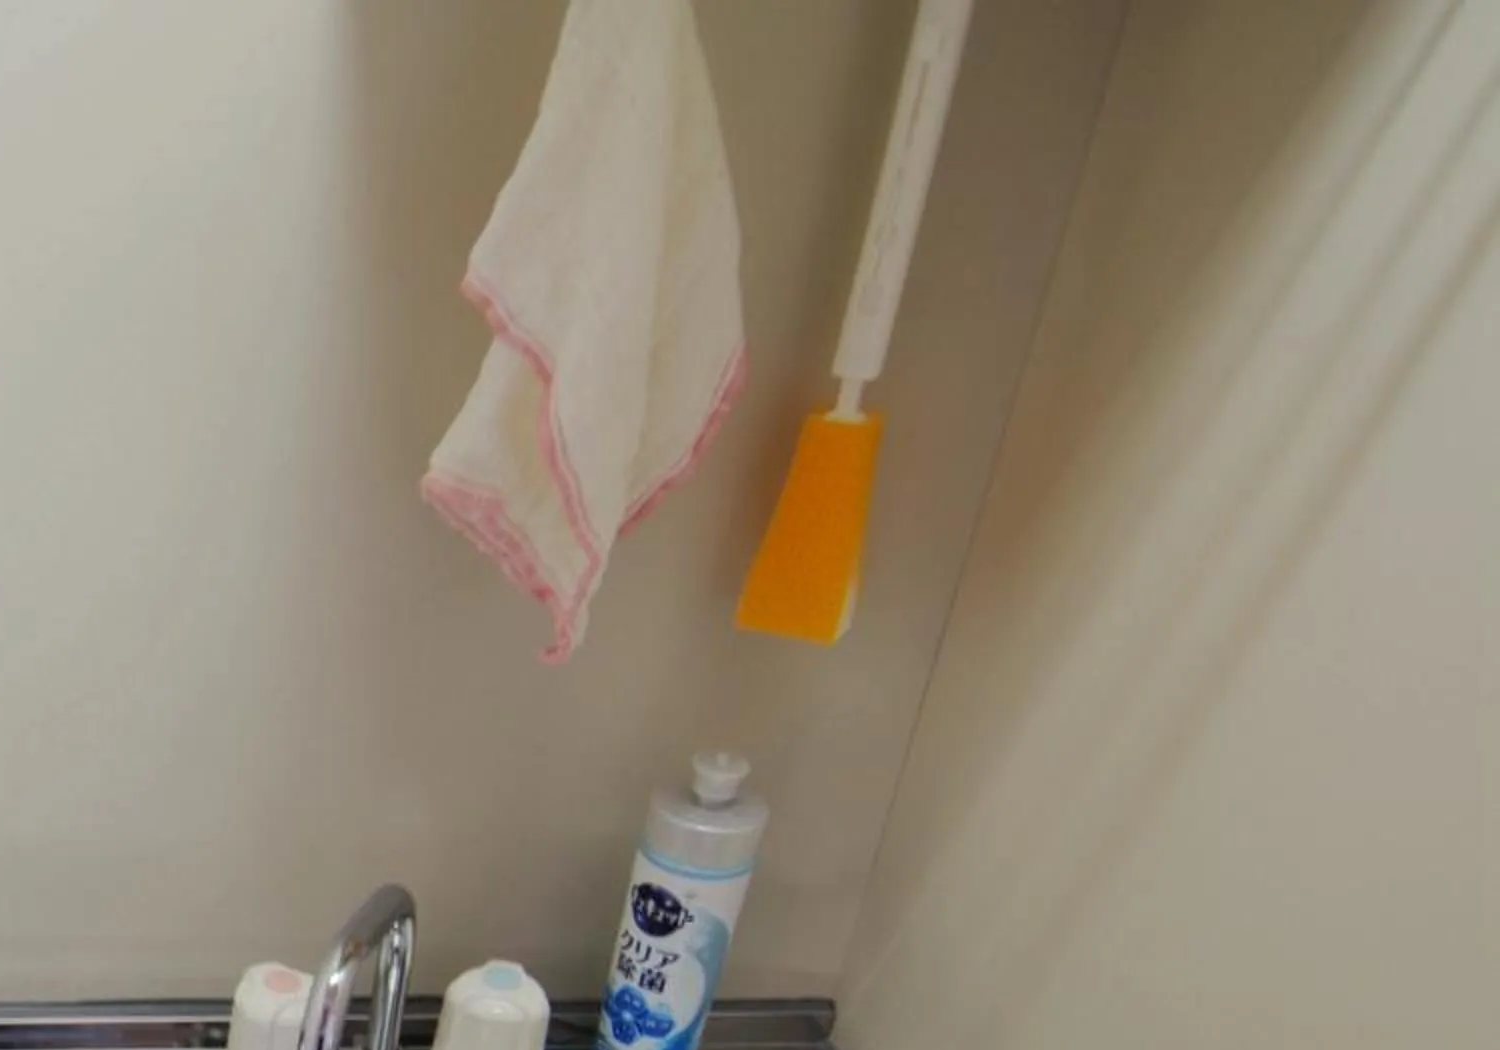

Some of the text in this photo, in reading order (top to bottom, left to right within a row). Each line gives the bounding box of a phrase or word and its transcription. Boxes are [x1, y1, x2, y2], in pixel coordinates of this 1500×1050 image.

[619, 929, 681, 970] クリア
[616, 951, 666, 994] 除菌
